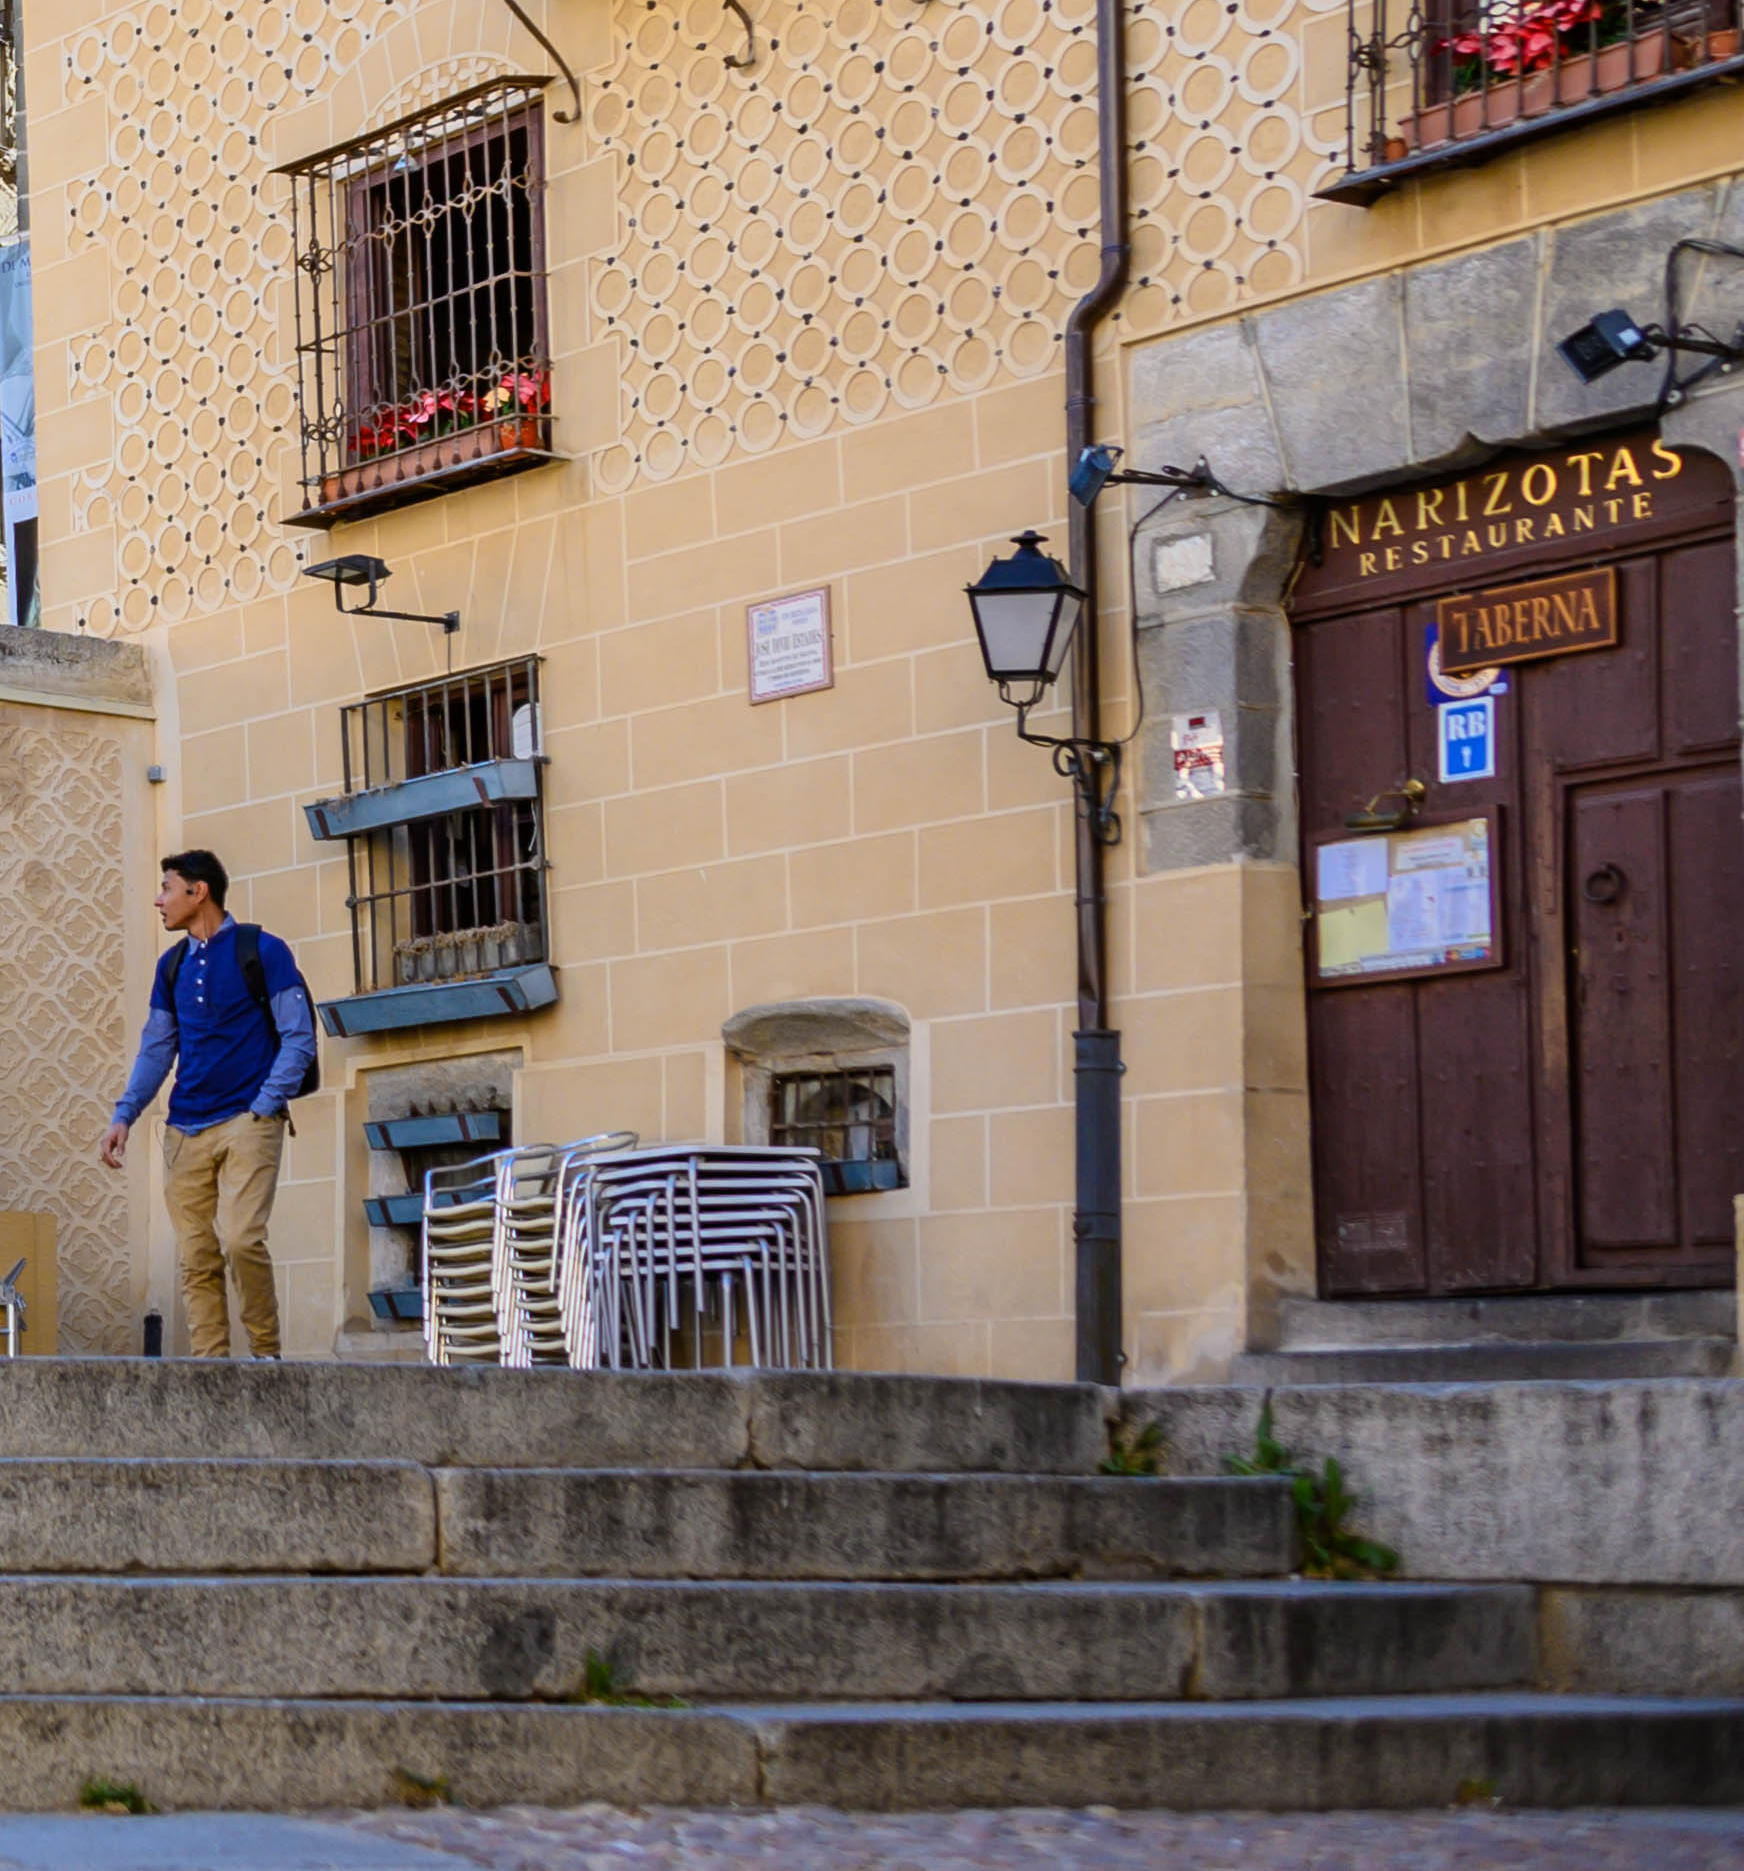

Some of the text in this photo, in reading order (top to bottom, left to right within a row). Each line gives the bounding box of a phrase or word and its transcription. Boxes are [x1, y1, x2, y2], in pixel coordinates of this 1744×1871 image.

[1329, 439, 1683, 549] NARIZOTAS
[1360, 492, 1653, 577] RESTAURANTE
[1452, 587, 1601, 654] TABERNA
[1446, 709, 1487, 742] RB
